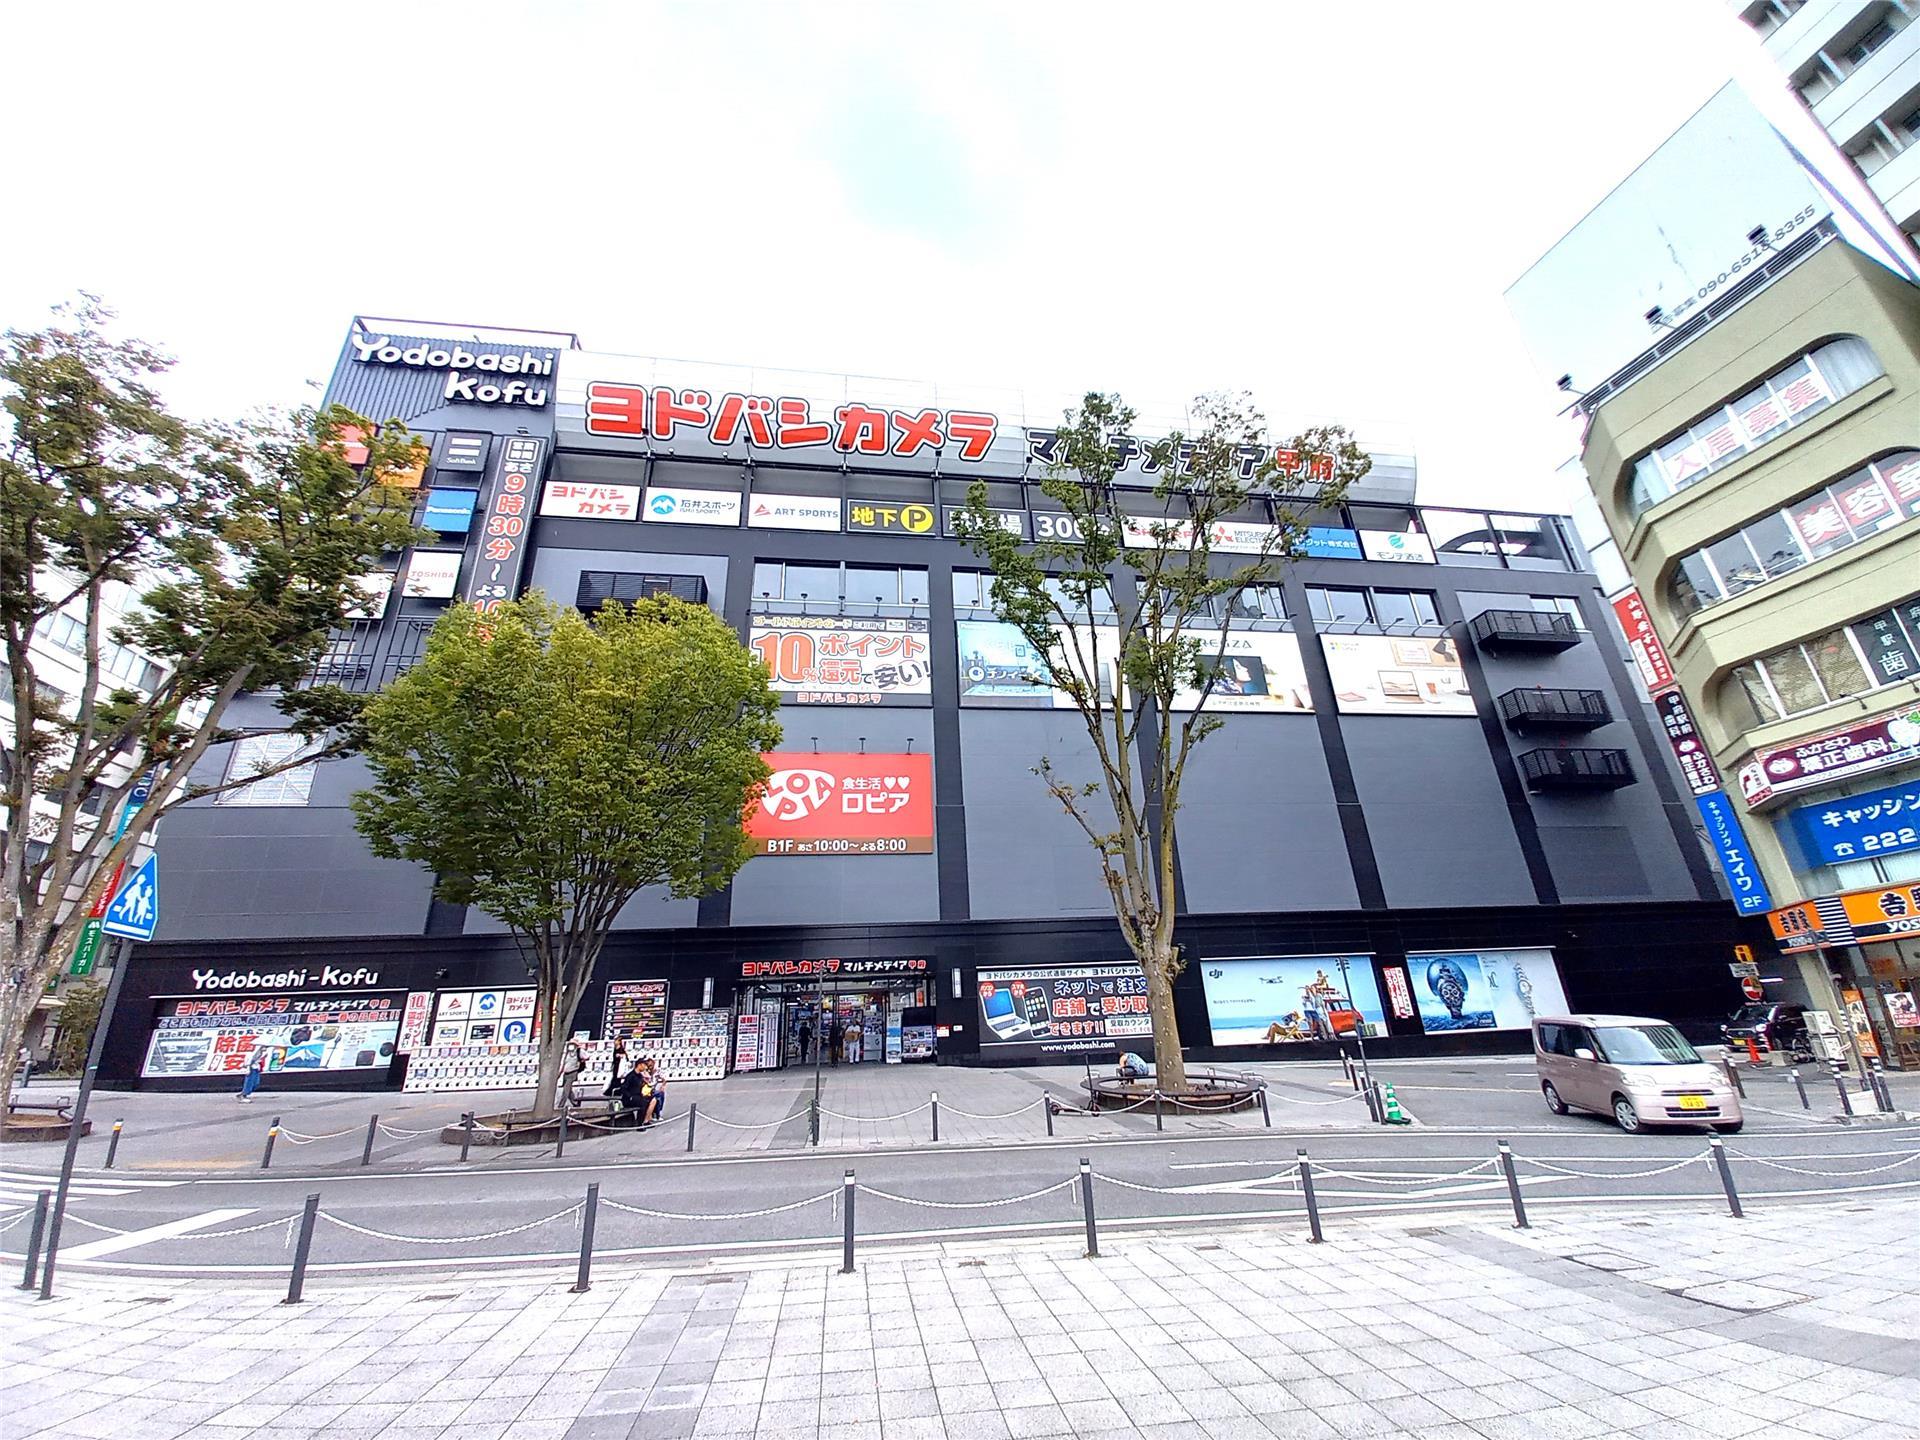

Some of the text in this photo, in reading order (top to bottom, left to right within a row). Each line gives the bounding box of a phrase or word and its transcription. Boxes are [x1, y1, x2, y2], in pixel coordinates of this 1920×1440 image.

[352, 334, 553, 376] Yodobashi
[444, 371, 547, 406] Kofu
[587, 381, 997, 463] ヨドバシカメラ
[1675, 378, 1820, 479] 入居募集
[446, 457, 476, 465] SoftBank
[551, 484, 625, 500] ヨドバシ
[577, 502, 631, 516] カメラ
[680, 499, 736, 511] 石井スポーツ
[774, 507, 839, 518] ART SPORTS
[851, 506, 897, 527] 地下
[410, 569, 454, 579] TOSHIBA
[819, 633, 926, 658] ポイント
[796, 692, 882, 704] ヨドバシカメラ
[1796, 736, 1850, 759] ふかさわ
[1800, 737, 1888, 774] 矯正歯科
[842, 776, 882, 790] 食生活
[841, 792, 910, 814] ロピア
[767, 839, 794, 852] B1F
[1862, 827, 1918, 852] 222
[1725, 848, 1754, 891] エイワ
[1741, 894, 1763, 908] 2F
[742, 959, 840, 976] ヨドバシカメラ
[175, 999, 290, 1016] ヨドバシカメラ
[1040, 1041, 1116, 1053] www.yodobashi.com
